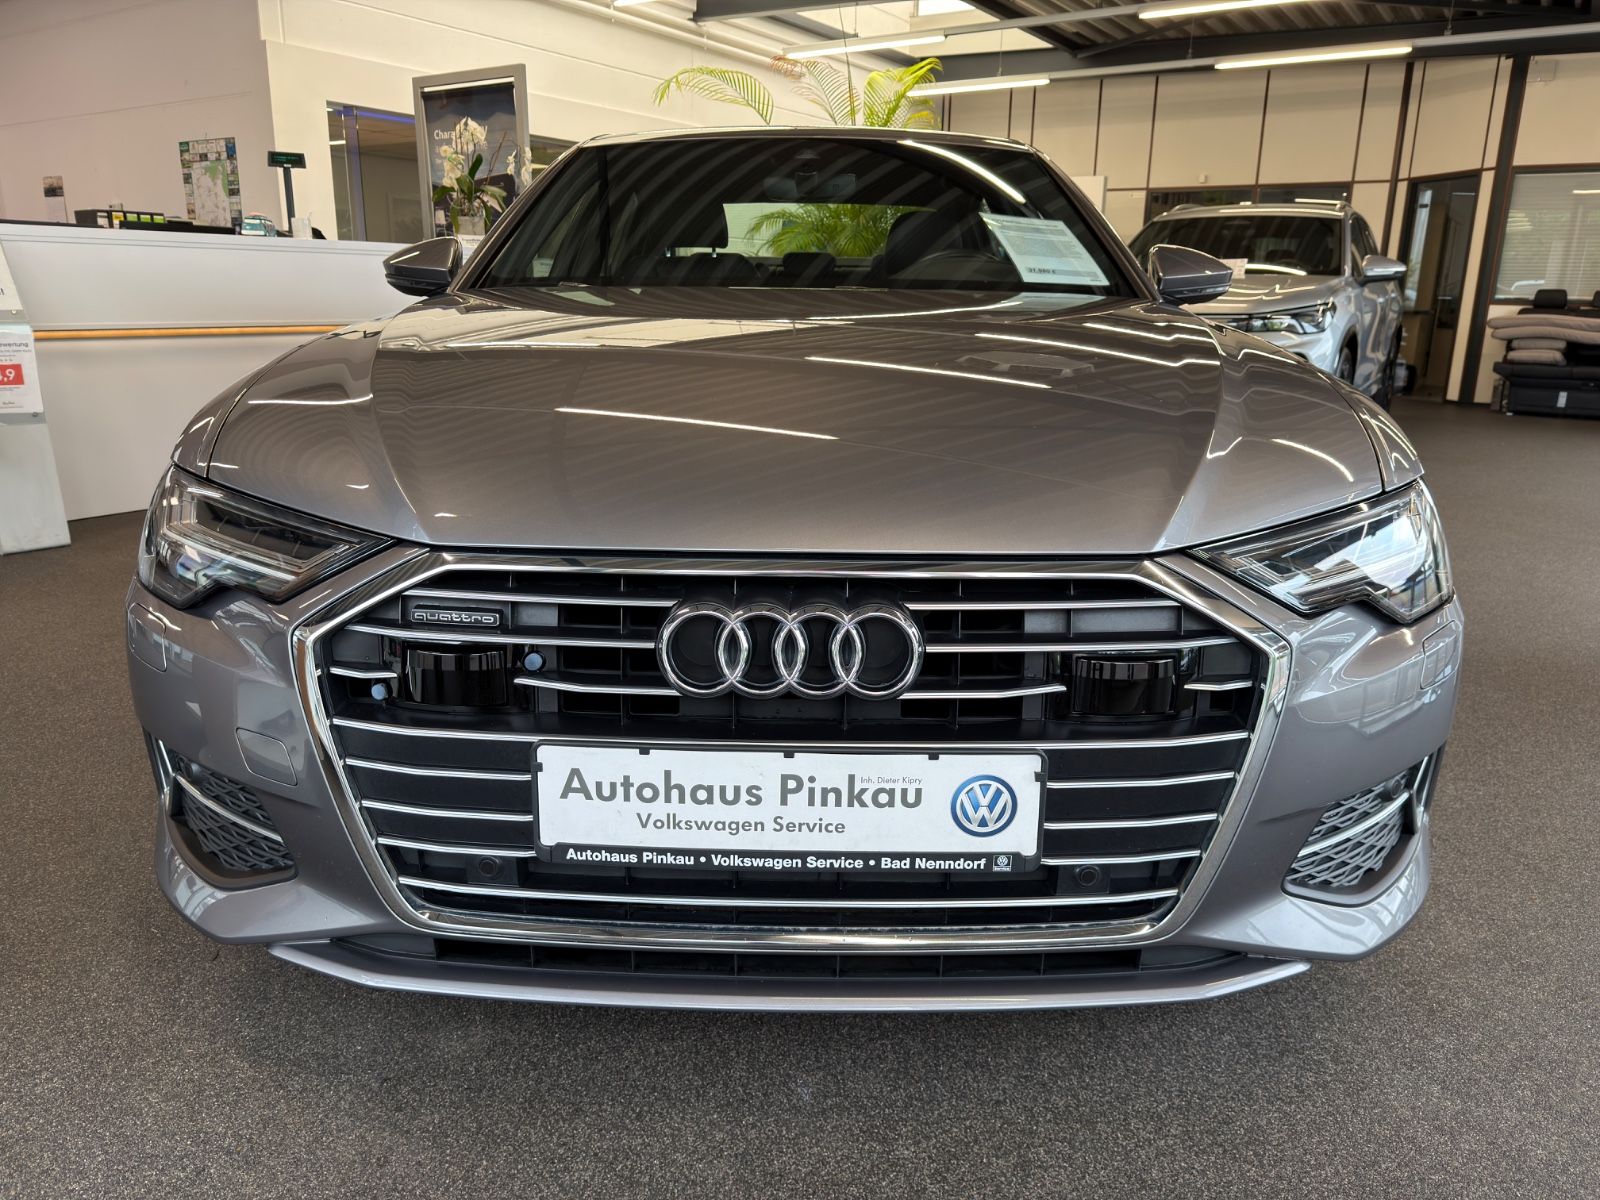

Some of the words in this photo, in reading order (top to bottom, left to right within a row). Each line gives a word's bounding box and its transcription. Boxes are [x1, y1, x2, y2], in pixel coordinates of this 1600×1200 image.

[414, 612, 495, 623] quattro
[560, 768, 763, 806] Autohaus
[780, 774, 923, 808] Pinkau
[860, 776, 875, 784] Inh.
[877, 776, 900, 784] Dieter
[902, 776, 922, 785] Kipry
[636, 812, 765, 835] Volkswagen
[773, 816, 846, 834] Service
[566, 848, 637, 863] Autohaus
[643, 851, 694, 865] Pinkau
[711, 854, 801, 869] Volkswagen
[807, 856, 863, 869] Service
[881, 857, 910, 869] Bad
[915, 857, 987, 870] Nenndorf
